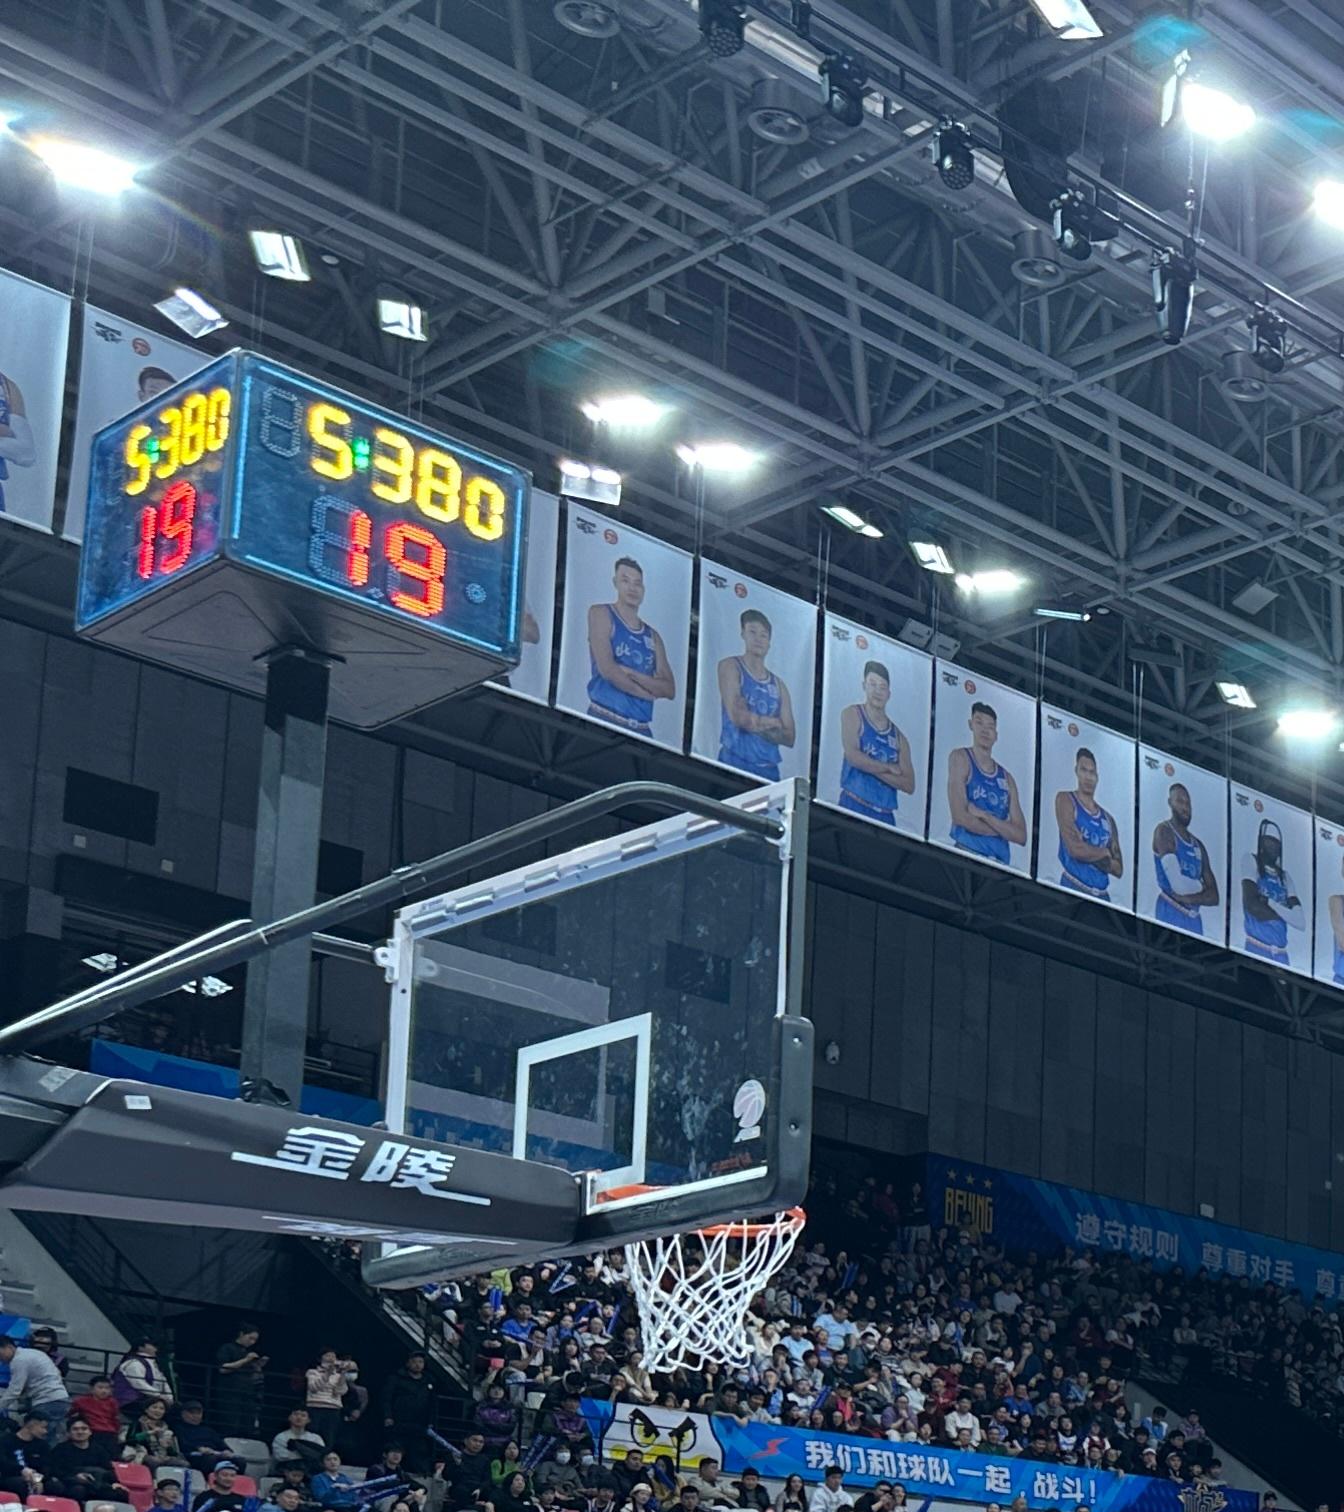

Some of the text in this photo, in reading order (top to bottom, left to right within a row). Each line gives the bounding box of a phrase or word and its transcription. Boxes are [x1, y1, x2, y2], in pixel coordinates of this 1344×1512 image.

[138, 480, 196, 579] 19
[348, 509, 447, 618] 19
[255, 1126, 478, 1203] 金陵
[1075, 1212, 1179, 1262] 遵守规则
[1201, 1241, 1296, 1288] 尊重对手
